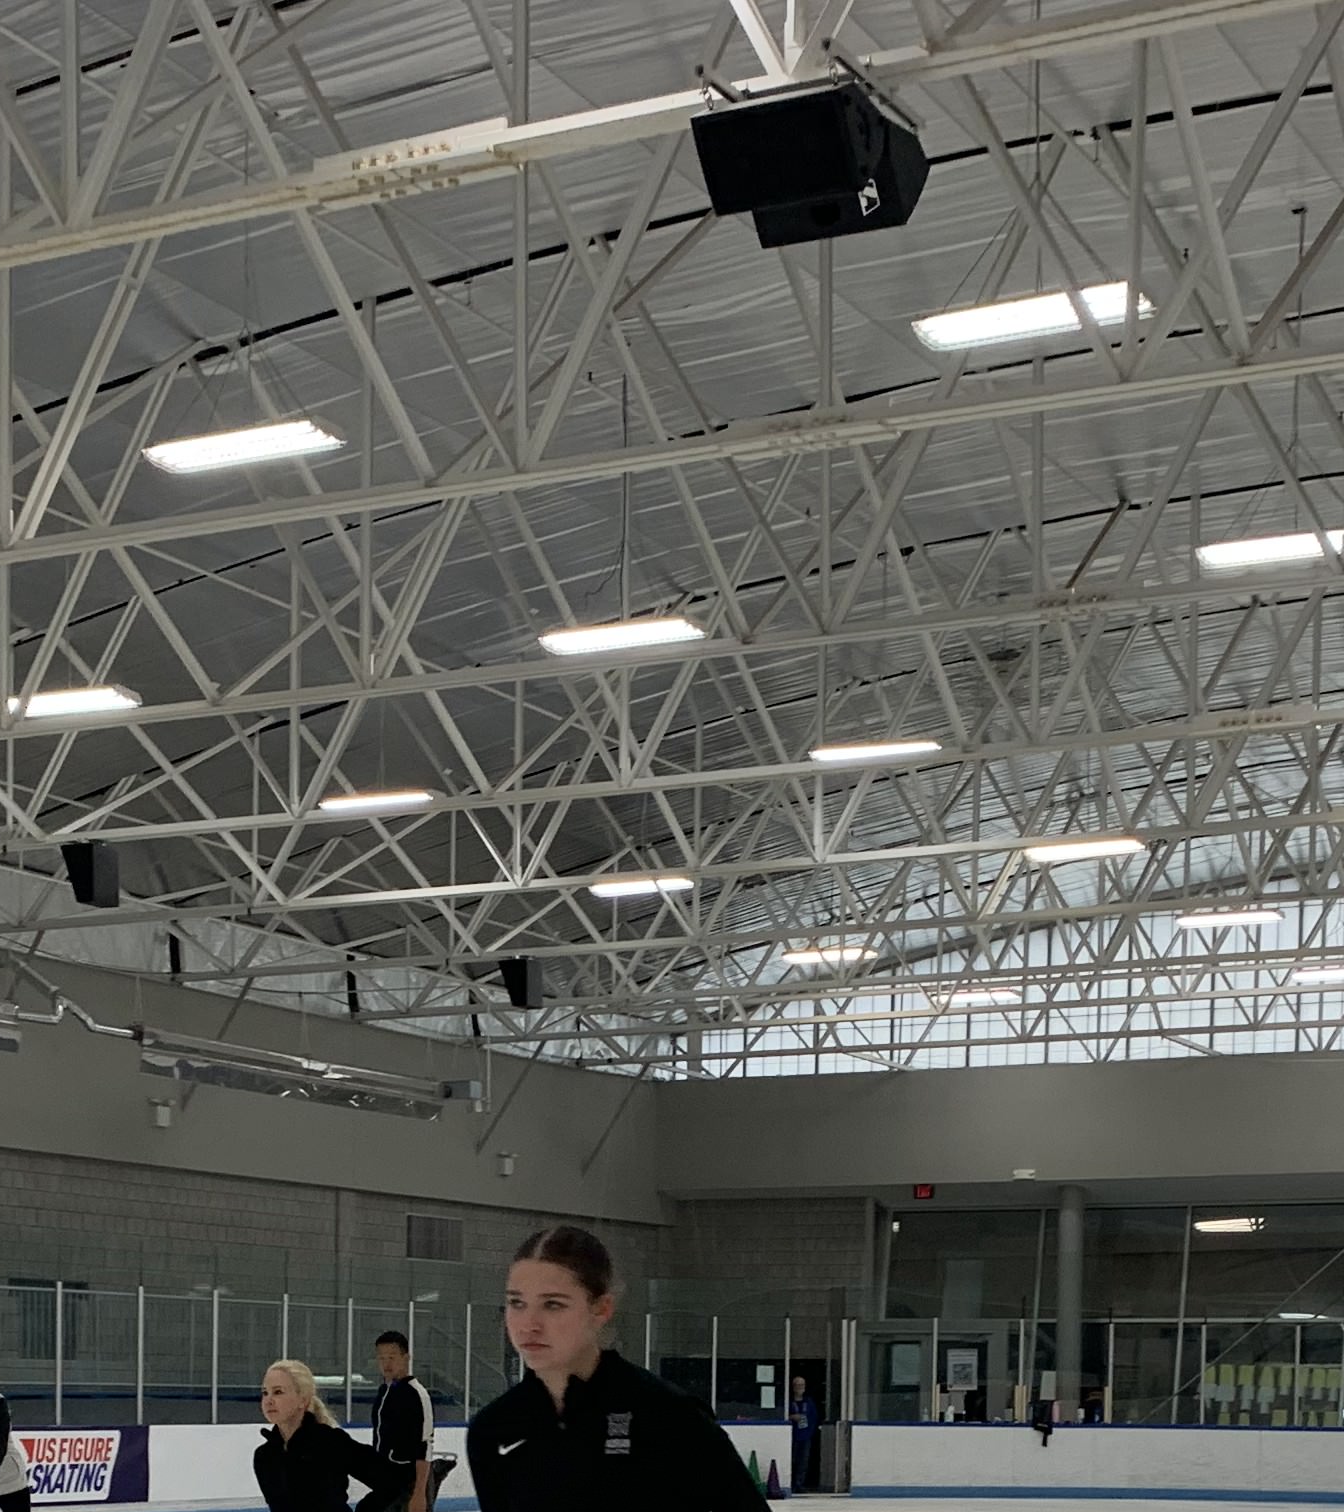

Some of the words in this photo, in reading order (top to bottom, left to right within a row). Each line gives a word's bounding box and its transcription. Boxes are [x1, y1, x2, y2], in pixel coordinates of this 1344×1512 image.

[35, 1438, 57, 1463] US
[58, 1437, 115, 1462] FIGURE
[30, 1463, 109, 1494] SKATING
